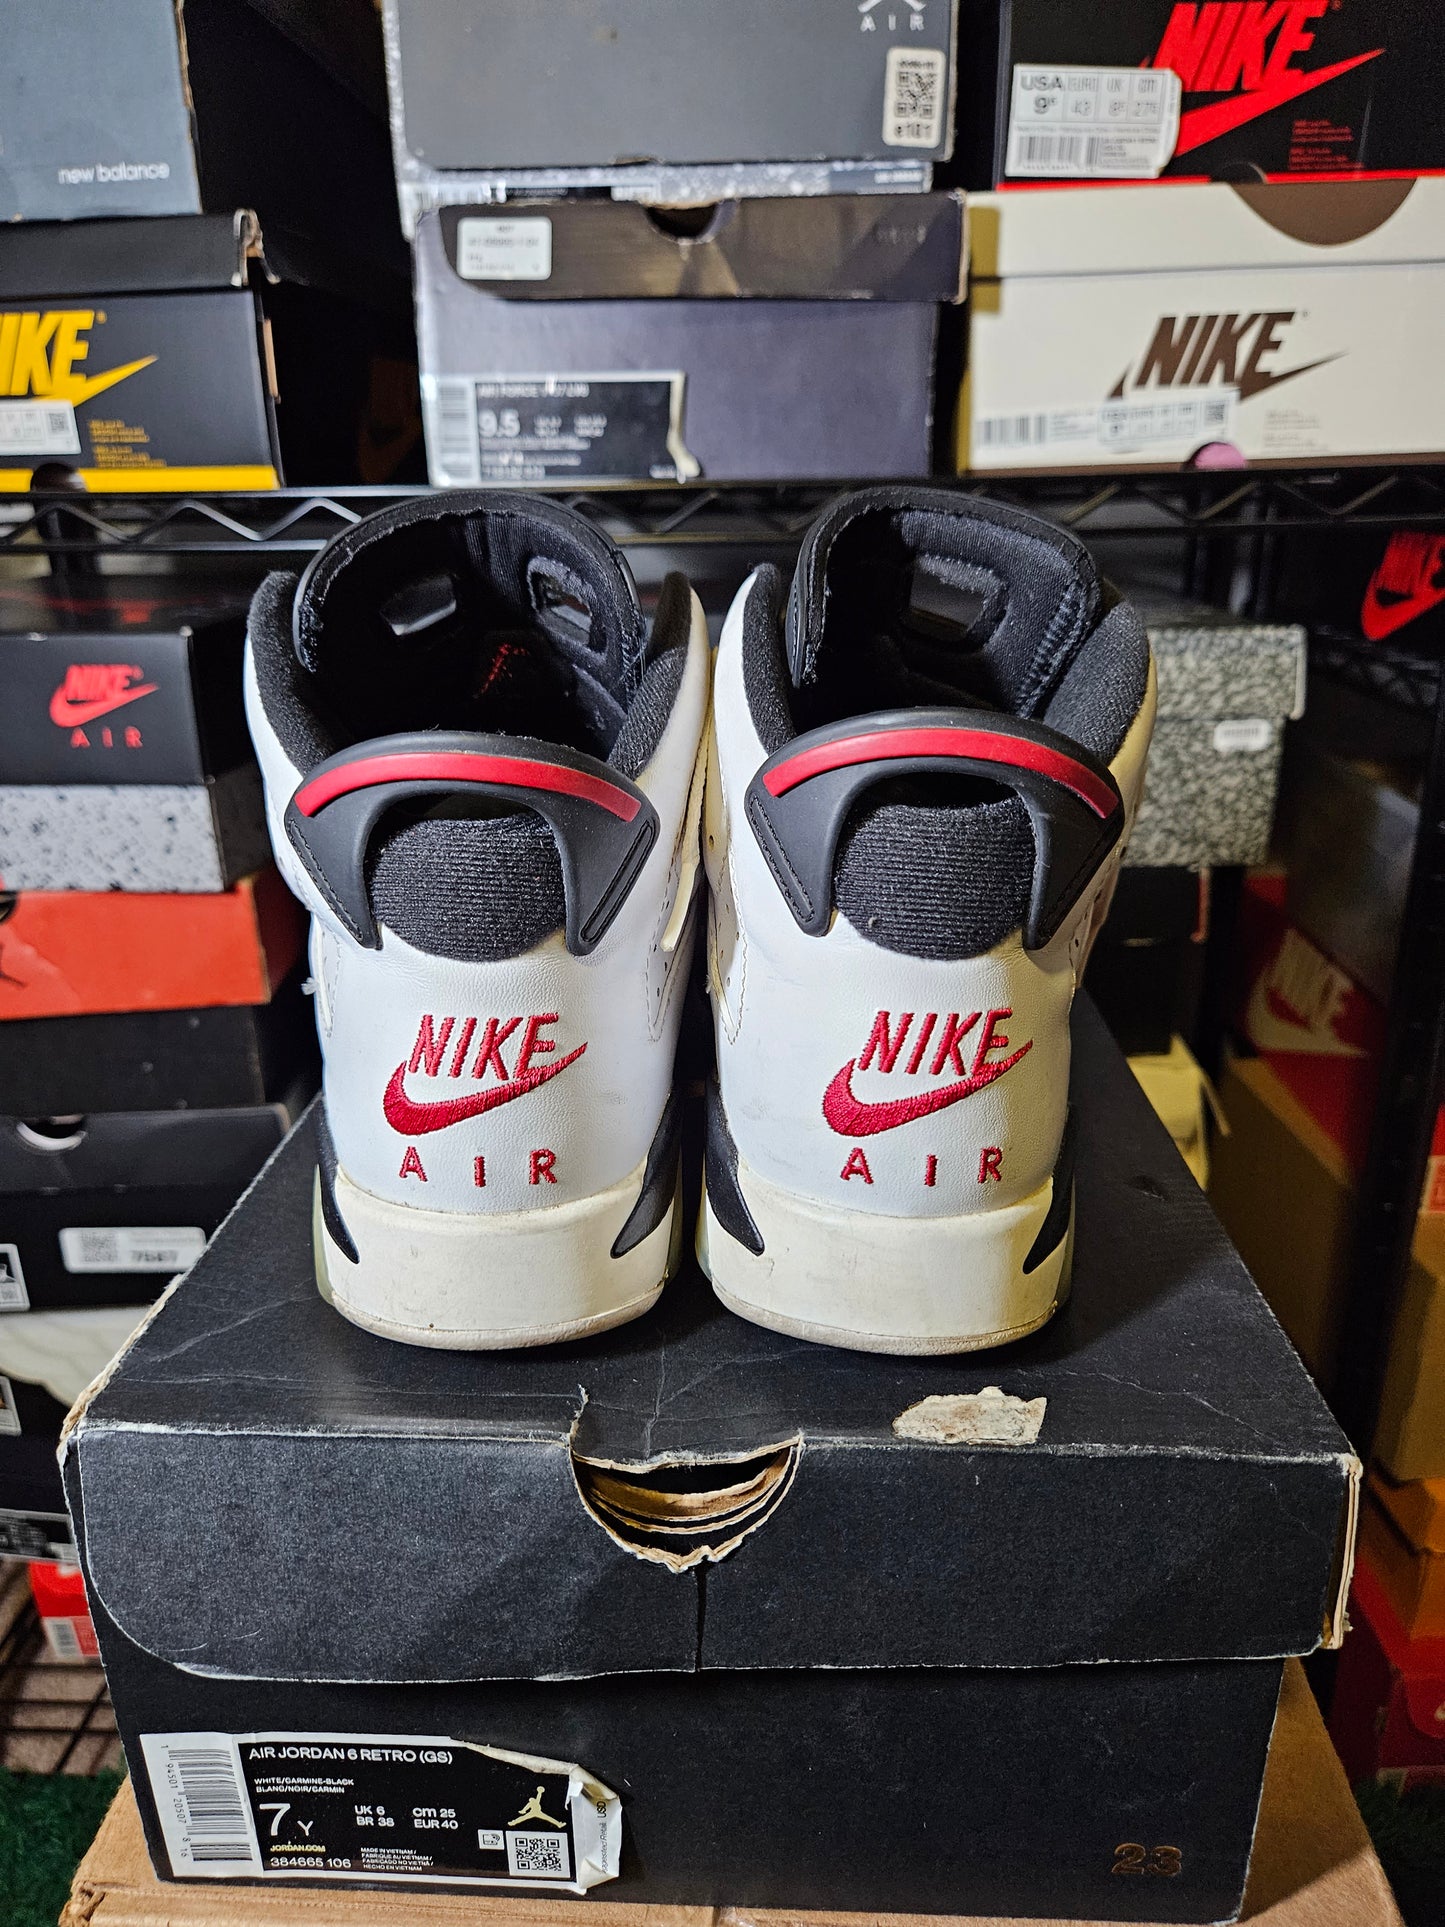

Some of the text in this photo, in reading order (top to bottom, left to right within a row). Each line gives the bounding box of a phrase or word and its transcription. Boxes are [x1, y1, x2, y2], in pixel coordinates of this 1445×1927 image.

[860, 14, 925, 32] AIR
[1152, 0, 1330, 91] NIKE
[1020, 74, 1063, 91] USA
[58, 161, 170, 184] new balance
[0, 309, 95, 396] IKE
[1132, 311, 1296, 389] NIKE
[65, 664, 134, 700] NIKE
[70, 727, 143, 749] AIR
[408, 1012, 559, 1081] NIKE
[858, 1007, 1013, 1077] NIKE
[399, 1146, 558, 1187] AIR
[840, 1147, 1003, 1187] AIR
[249, 1746, 453, 1765] AIR JORDAN 6 RETRO (GS)
[254, 1776, 354, 1786] WHITE/CARMINE-BLACK
[256, 1785, 345, 1794] BLANC/NOIR/CARMIN
[354, 1805, 386, 1816] UK 6
[439, 1808, 456, 1818] 25
[596, 1801, 607, 1818] USD
[259, 1803, 314, 1837] 7 Y
[356, 1816, 395, 1827] BR 38
[413, 1819, 458, 1830] EUR 40
[270, 1844, 326, 1852] JORDAN.COM
[270, 1857, 351, 1869] 384665 106
[1111, 1842, 1183, 1877] 23
